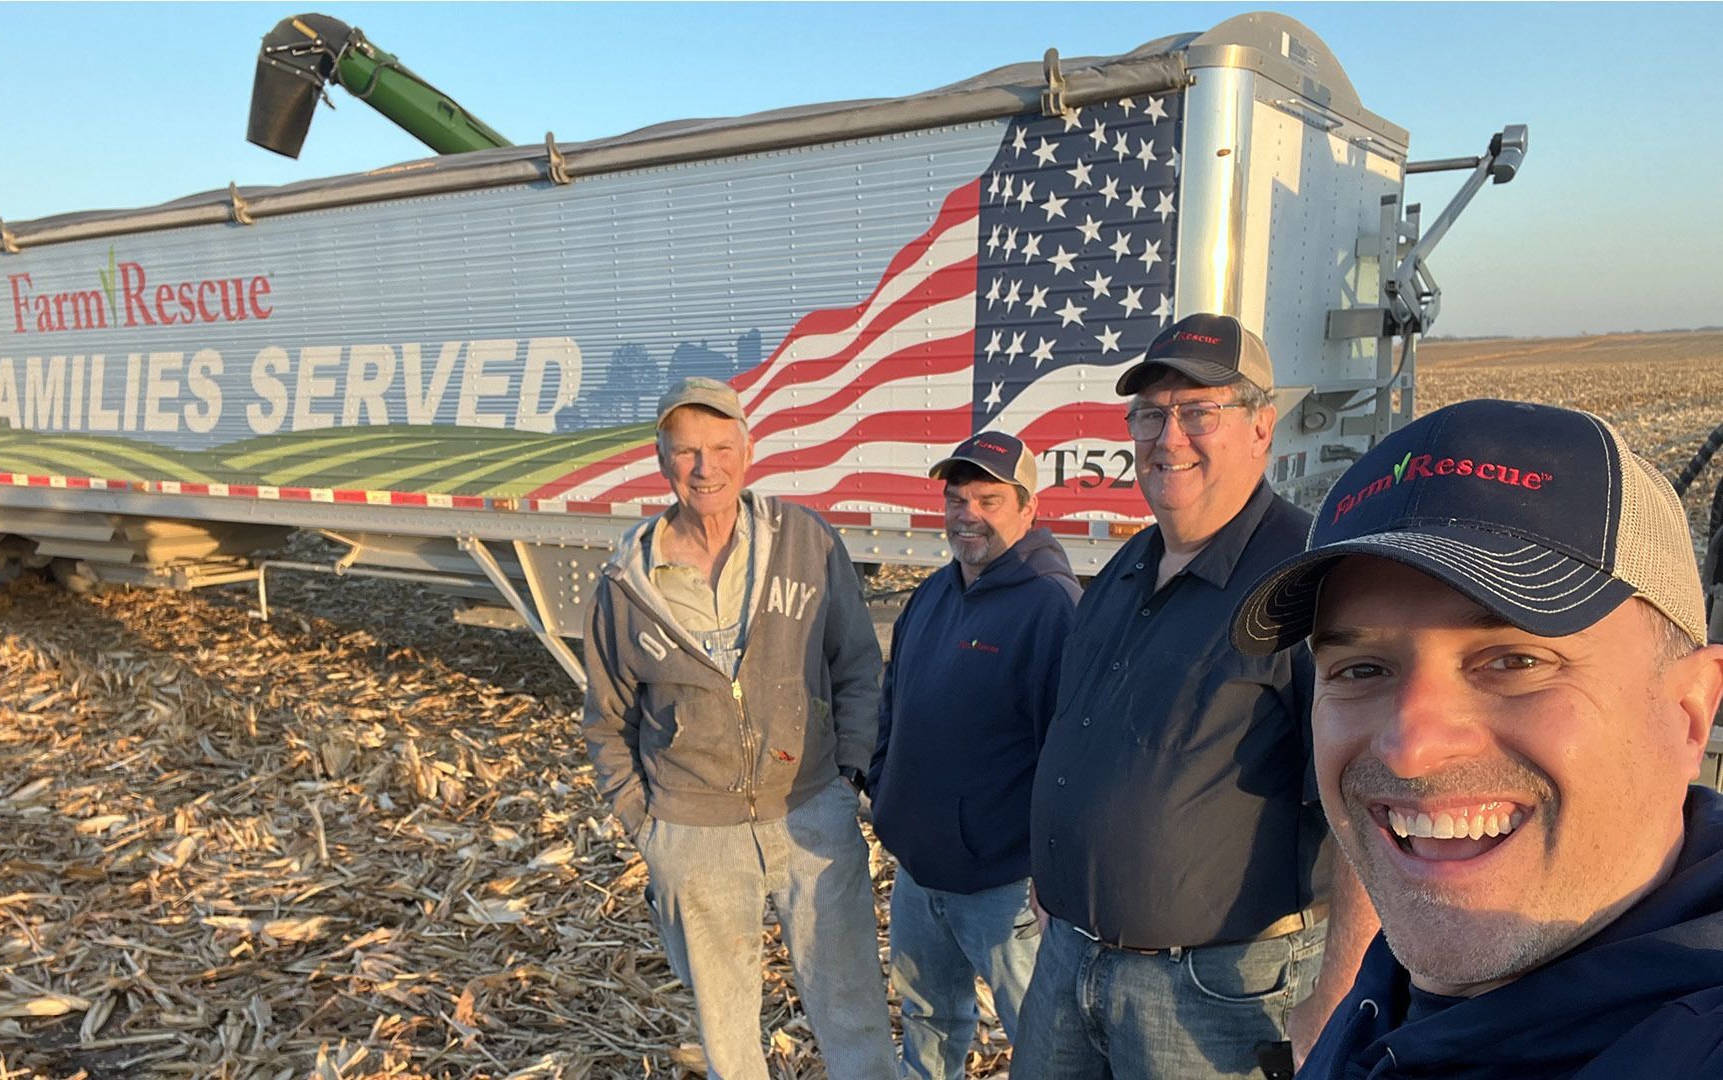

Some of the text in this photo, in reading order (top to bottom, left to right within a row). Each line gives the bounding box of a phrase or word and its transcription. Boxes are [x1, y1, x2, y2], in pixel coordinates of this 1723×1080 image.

[7, 261, 274, 333] Farm Rescue
[246, 336, 582, 435] SERVED
[1332, 474, 1393, 526] Farm
[1403, 454, 1542, 491] Rescue
[762, 576, 817, 621] AVY
